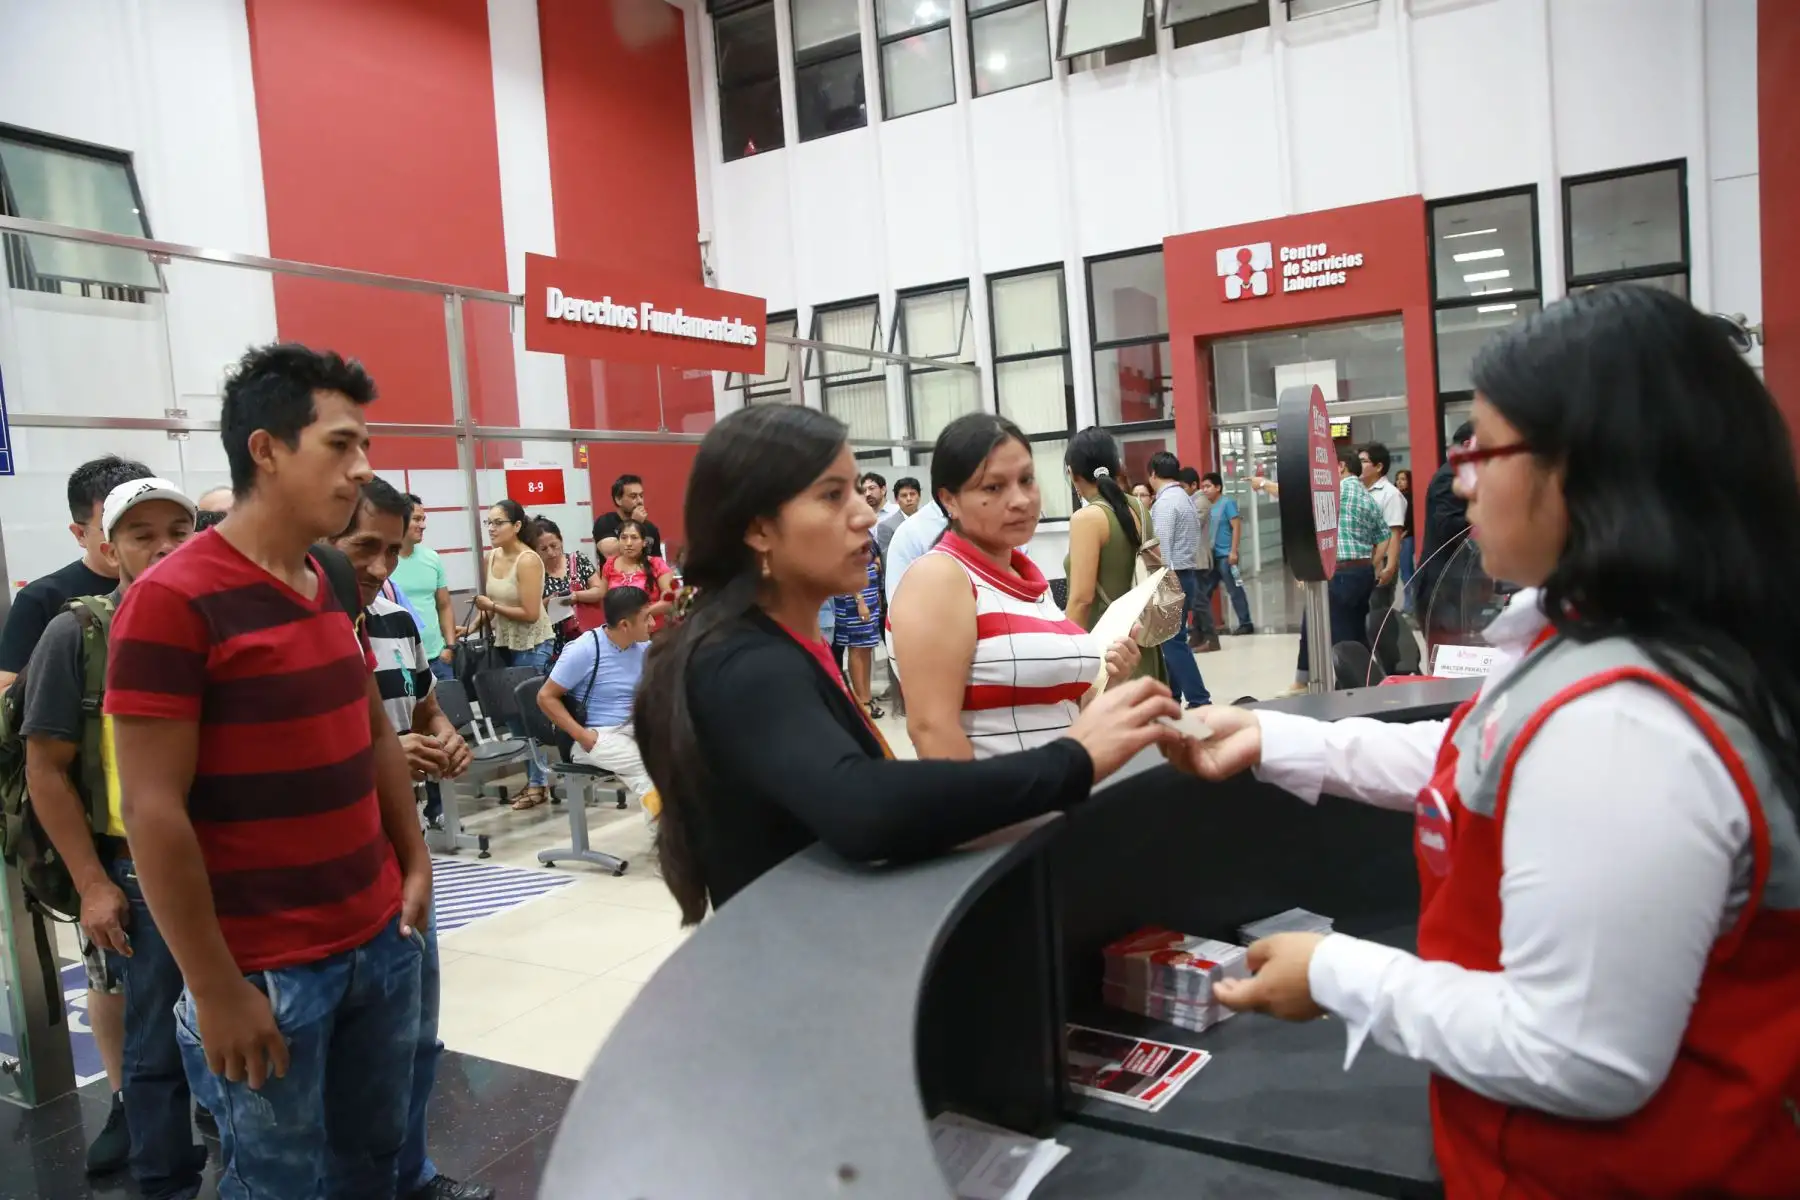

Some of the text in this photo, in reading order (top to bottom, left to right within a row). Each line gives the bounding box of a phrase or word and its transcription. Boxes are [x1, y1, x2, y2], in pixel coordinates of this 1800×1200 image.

[1280, 242, 1327, 261] Centro
[1283, 253, 1363, 277] de Servicios
[1283, 270, 1346, 292] Laborales
[546, 286, 758, 347] Derechos Fundamentales
[528, 481, 544, 492] 8-9
